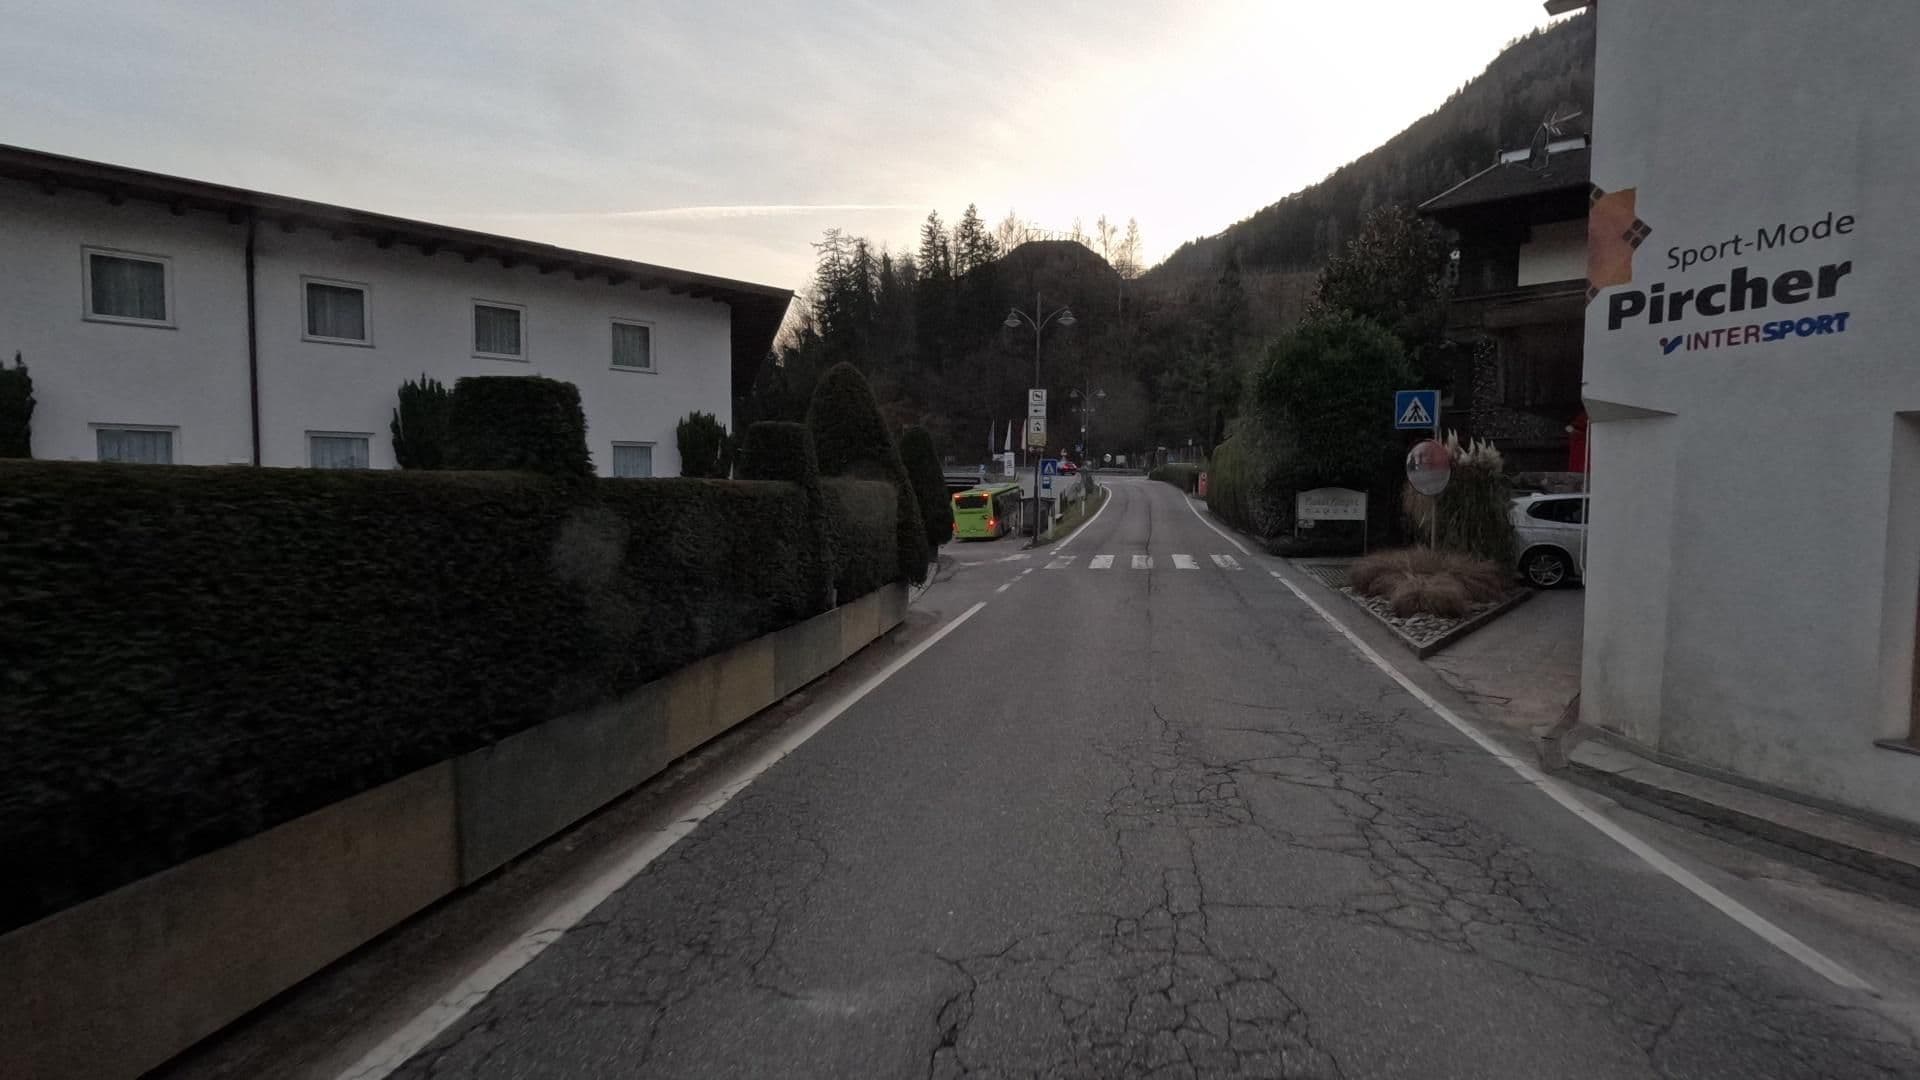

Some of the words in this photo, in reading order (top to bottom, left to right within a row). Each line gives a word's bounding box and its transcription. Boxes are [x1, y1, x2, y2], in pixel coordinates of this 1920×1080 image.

[1667, 212, 1855, 272] Sport-Mode
[1608, 261, 1852, 330] Pircher
[1686, 312, 1850, 351] INTERSPORT
